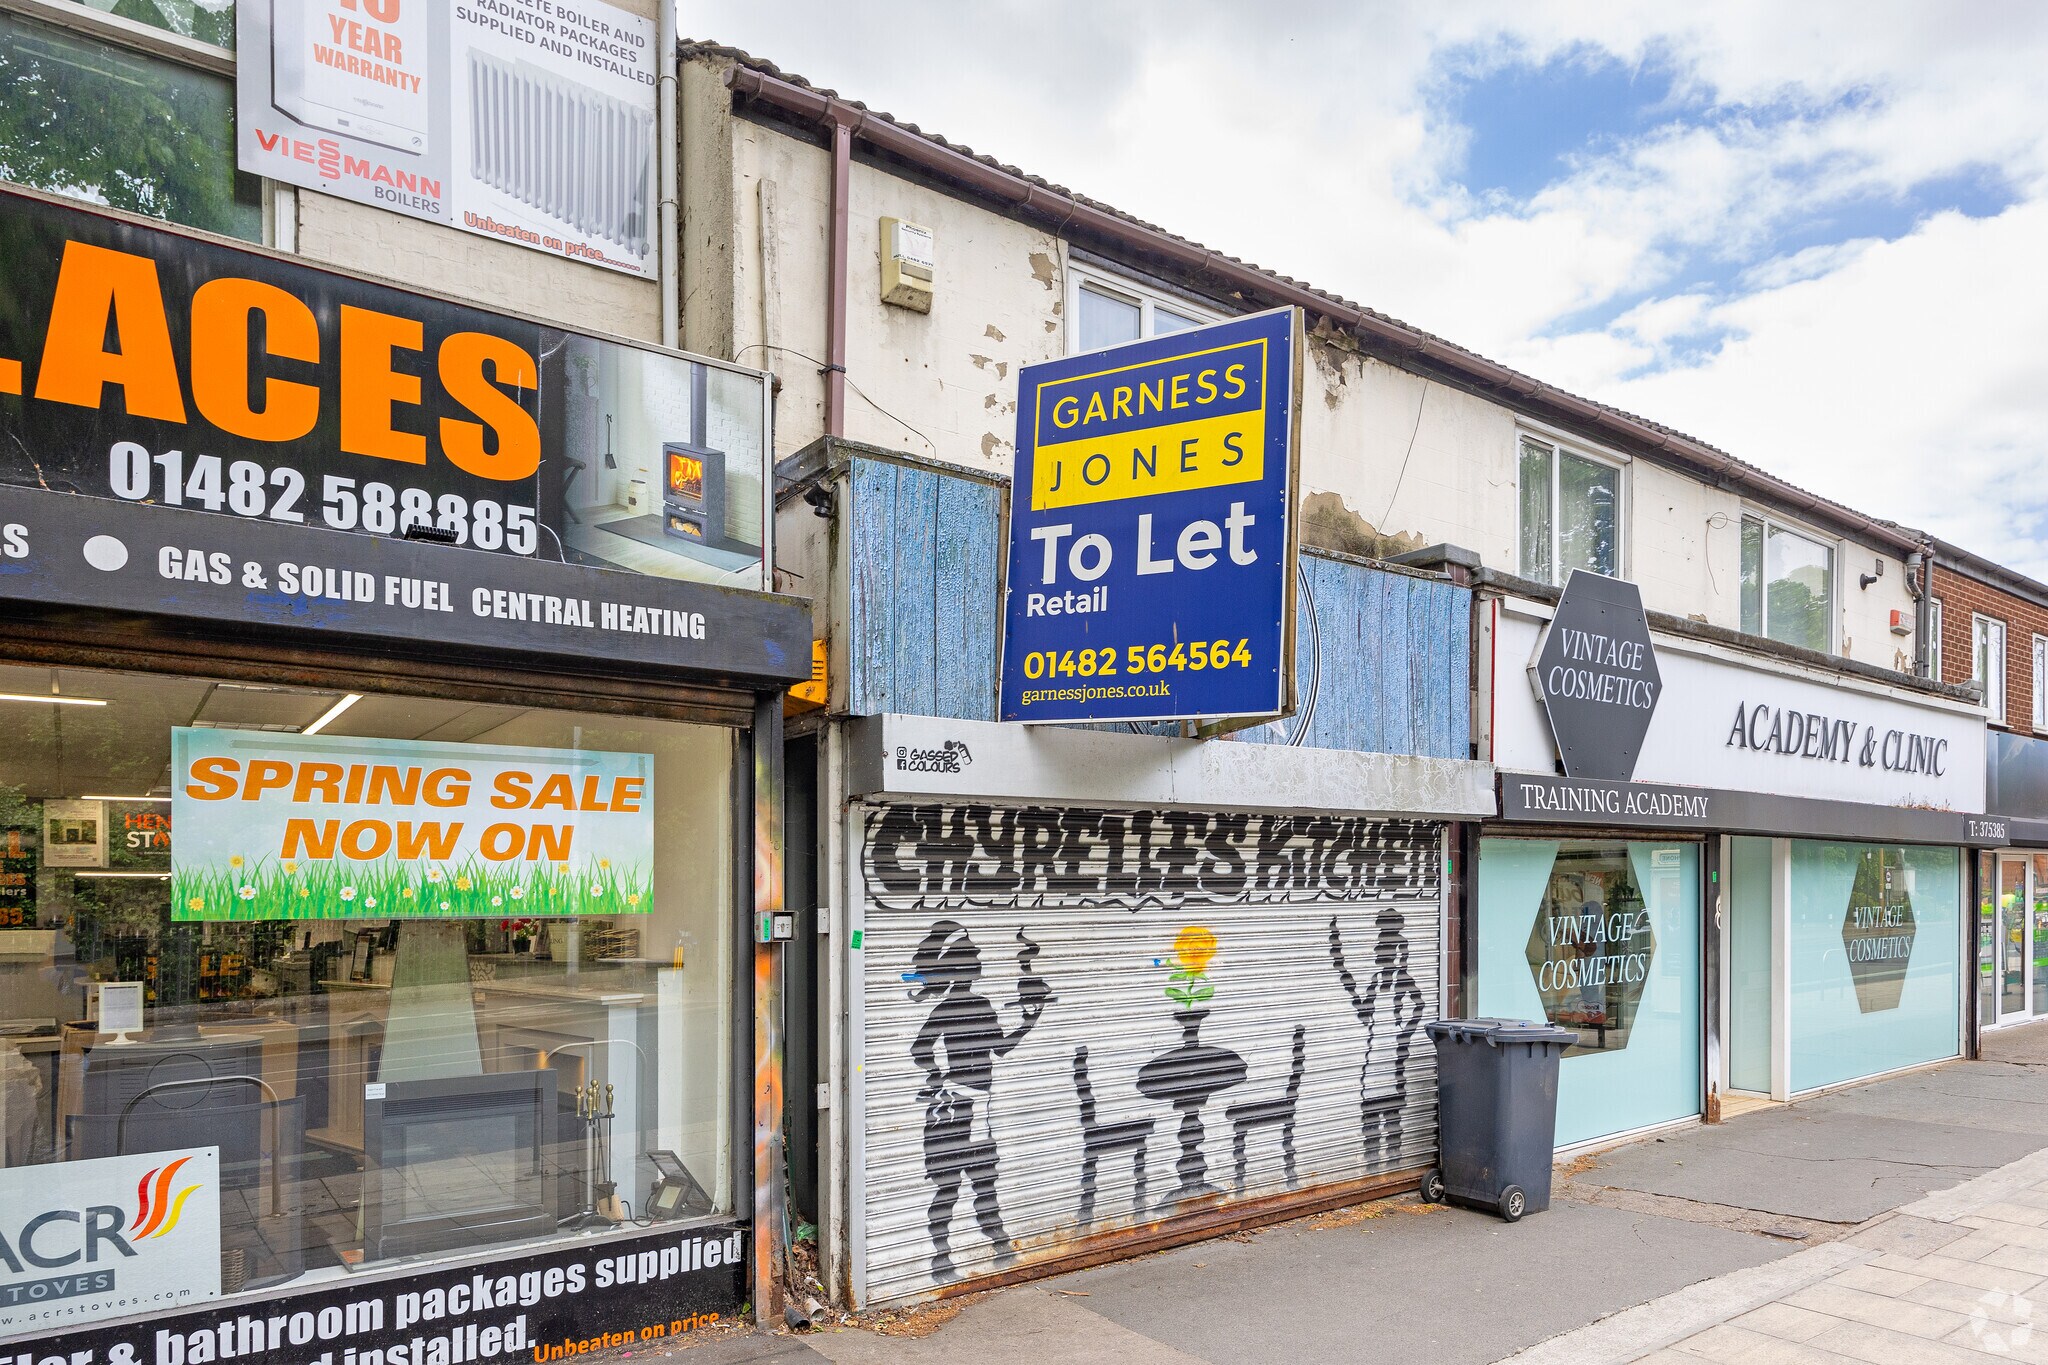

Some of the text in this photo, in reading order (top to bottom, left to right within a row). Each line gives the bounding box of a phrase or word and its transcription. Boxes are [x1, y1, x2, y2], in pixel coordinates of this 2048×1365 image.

[328, 13, 402, 65] YEAR
[456, 6, 656, 87] SUPPLIED AND INSTALLED
[477, 0, 638, 63] RADIATOR PACKAGES
[556, 6, 610, 36] BOILER
[614, 28, 645, 48] AND
[313, 43, 421, 94] WARRANTY
[374, 185, 441, 214] BOILERS
[464, 211, 541, 245] Unbeaten
[543, 235, 563, 251] on
[0, 239, 542, 481] ACES
[1053, 363, 1246, 429] GARNESS
[1050, 432, 1244, 492] JONES
[109, 441, 537, 556] 01482 588885
[1031, 502, 1259, 584] To Let
[158, 546, 706, 640] GAS & SOLID FUEL CENTRAL HEATING
[1027, 585, 1108, 617] Retail
[1023, 638, 1252, 680] 01482 564564
[1561, 627, 1645, 671] VINTAGE
[1021, 680, 1171, 706] garnessjones.co.uk
[1549, 665, 1654, 709] COSMETICS
[909, 748, 959, 763] GASSED
[1725, 700, 1949, 777] ACADEMY & CLINIC
[184, 756, 646, 813] SPRING SALE
[908, 760, 961, 774] COLOURS
[1520, 783, 1709, 818] TRAINING ACADEMY
[279, 818, 576, 862] NOW ON
[1968, 820, 2005, 839] T: 375385
[1548, 912, 1634, 947] VINTAGE
[1855, 905, 1904, 929] VINTAGE
[1849, 936, 1911, 962] COSMETICS
[1539, 953, 1647, 993] COSMETICS
[155, 1299, 384, 1365] bathroom
[396, 1264, 586, 1329] packages
[595, 1231, 742, 1288] supplied
[533, 1312, 720, 1363] Unbeaten on price
